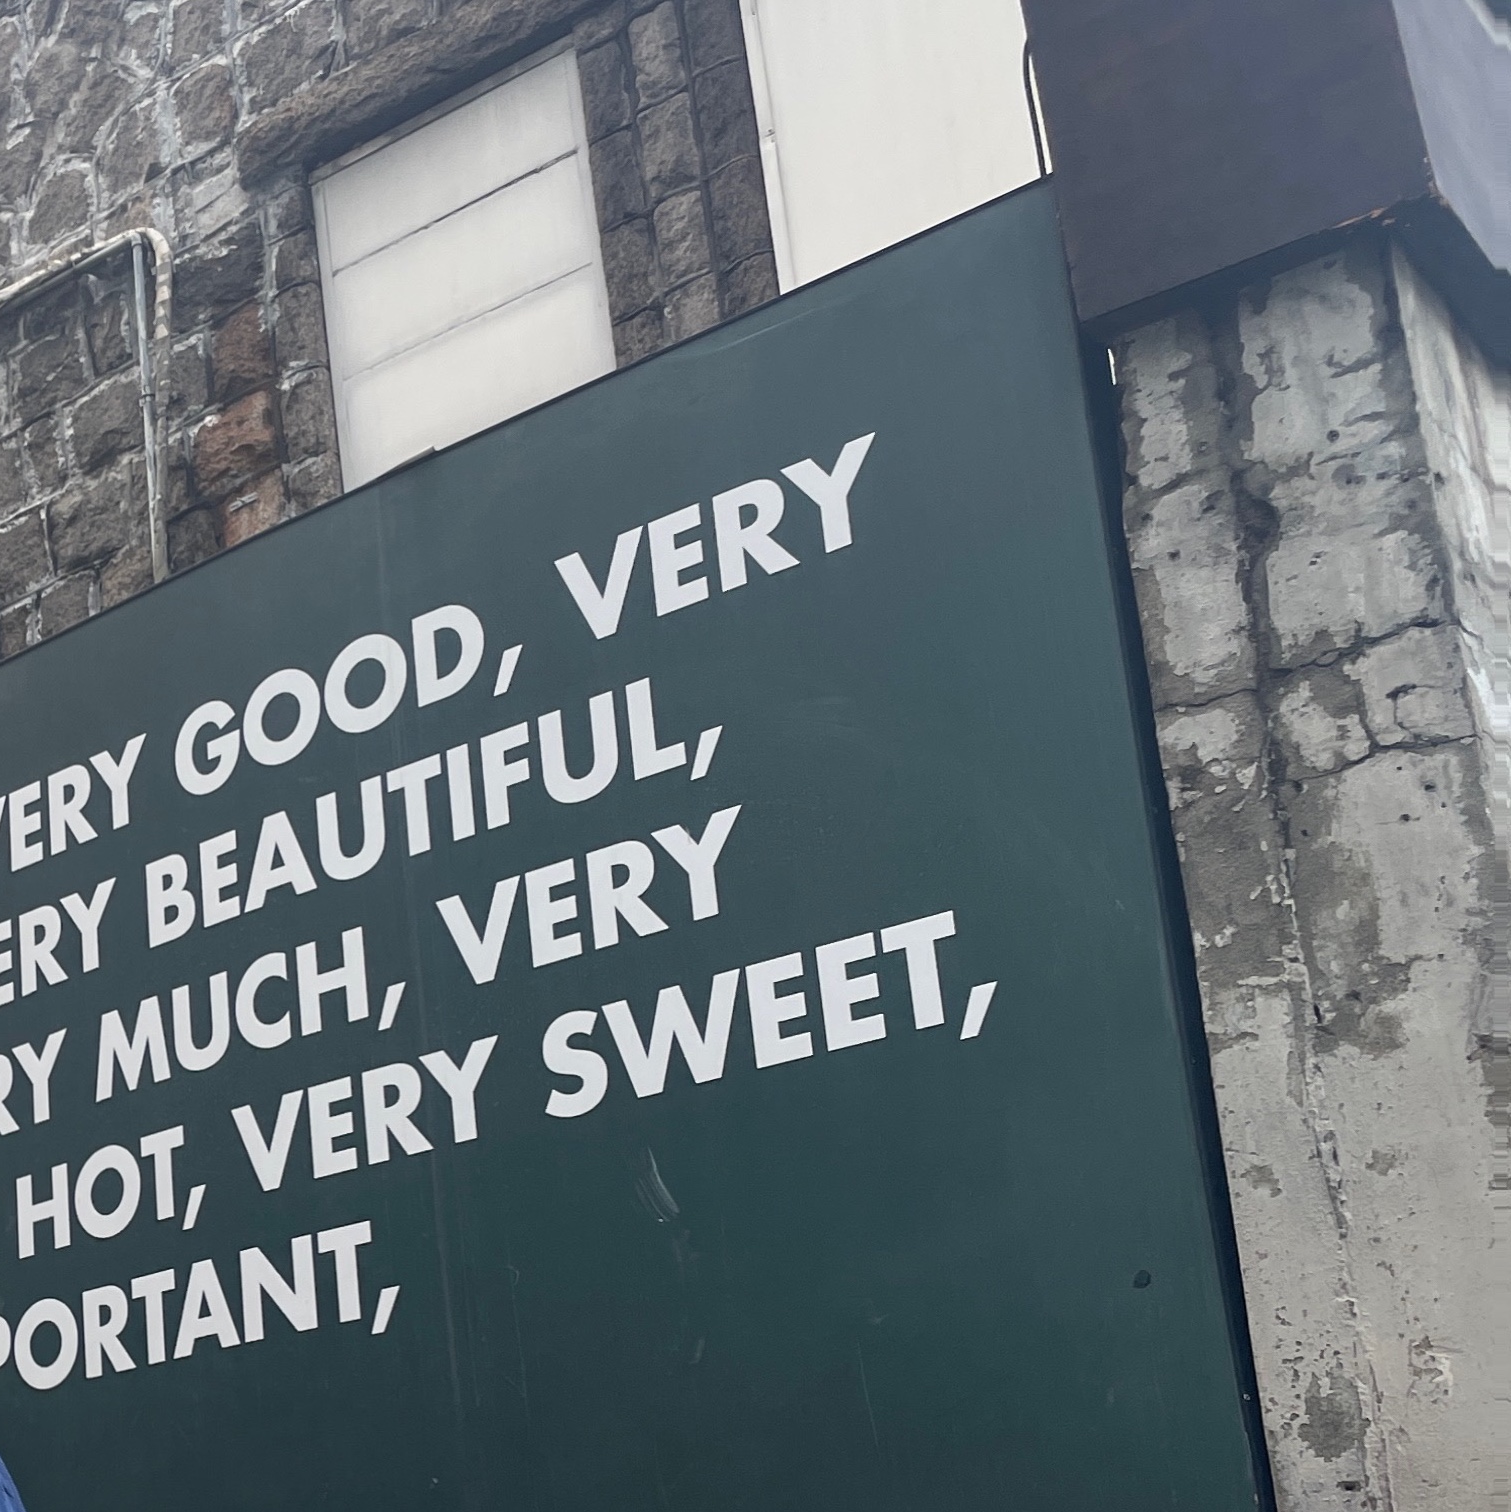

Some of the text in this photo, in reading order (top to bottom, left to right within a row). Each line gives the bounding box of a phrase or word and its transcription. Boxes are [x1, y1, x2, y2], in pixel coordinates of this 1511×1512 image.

[175, 605, 522, 795] GOOD,
[554, 432, 875, 640] VERY
[96, 926, 406, 1102] MUCH,
[436, 804, 742, 985] VERY
[146, 677, 722, 948] BEAUTIFUL,
[16, 1125, 206, 1259] HOT,
[231, 1034, 498, 1191] VERY
[542, 910, 997, 1118] SWEET,
